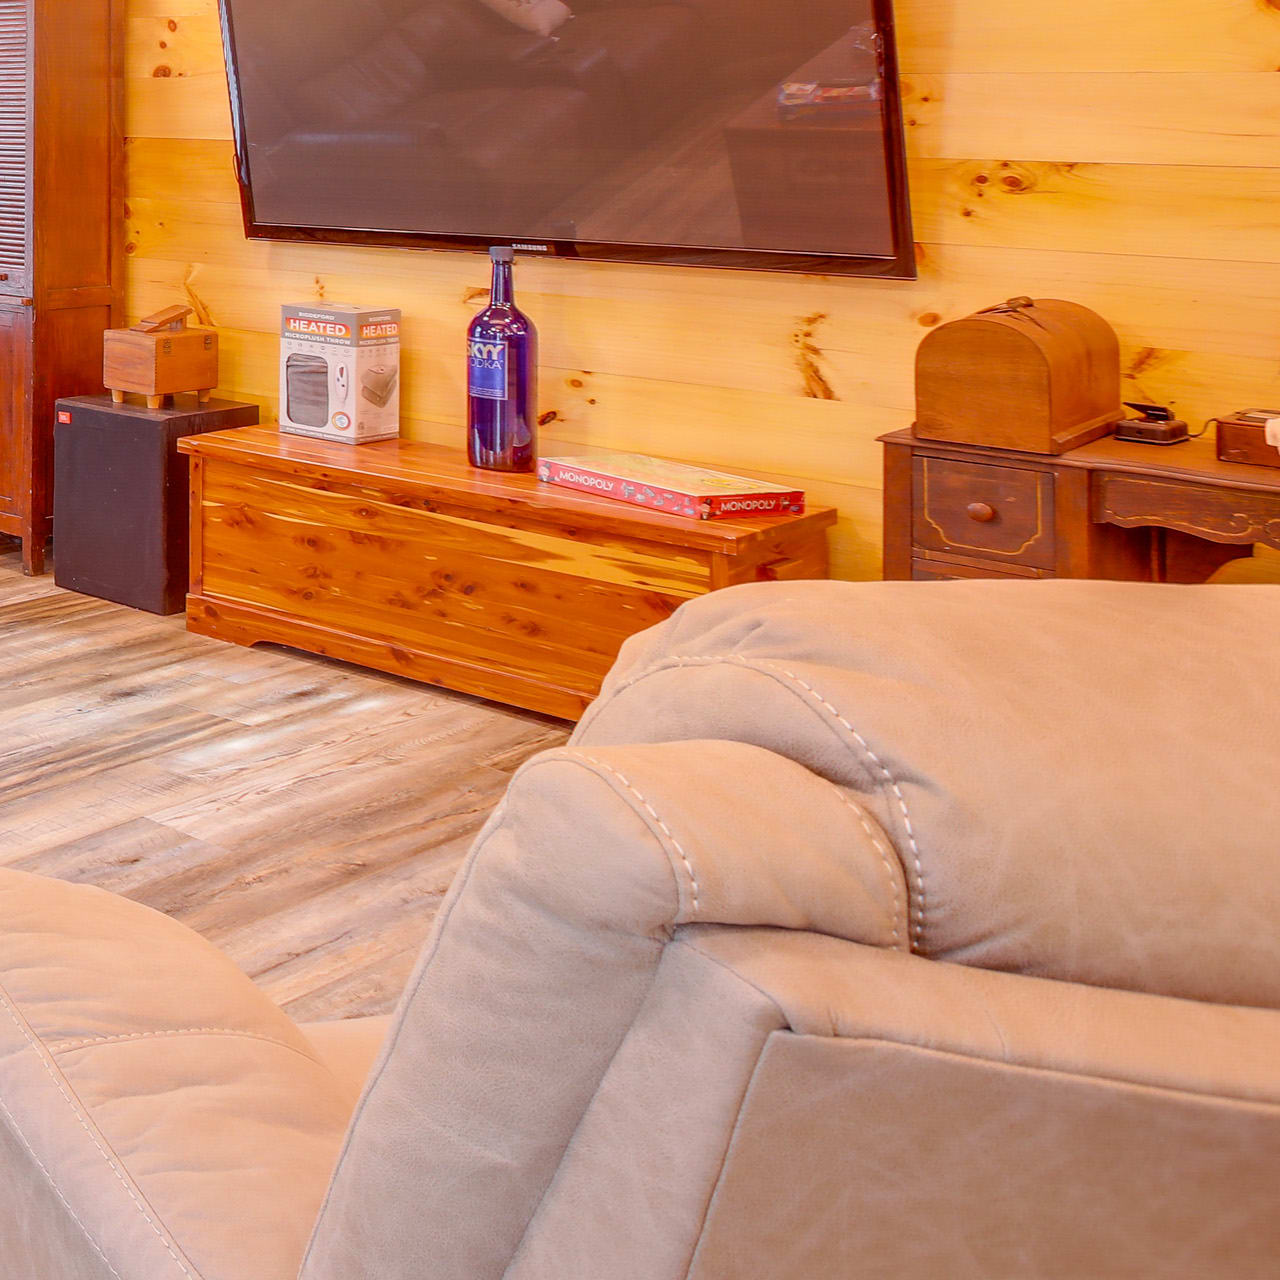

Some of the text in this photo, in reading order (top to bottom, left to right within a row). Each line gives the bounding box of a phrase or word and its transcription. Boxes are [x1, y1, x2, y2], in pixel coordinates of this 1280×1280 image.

[290, 319, 346, 336] HEATED
[363, 323, 398, 337] HEATED
[284, 332, 325, 342] MICROPLUSH
[326, 337, 352, 345] THROW
[470, 357, 502, 370] ODKA
[559, 470, 614, 491] MONOPOLY
[721, 500, 776, 512] MONOPOLY
